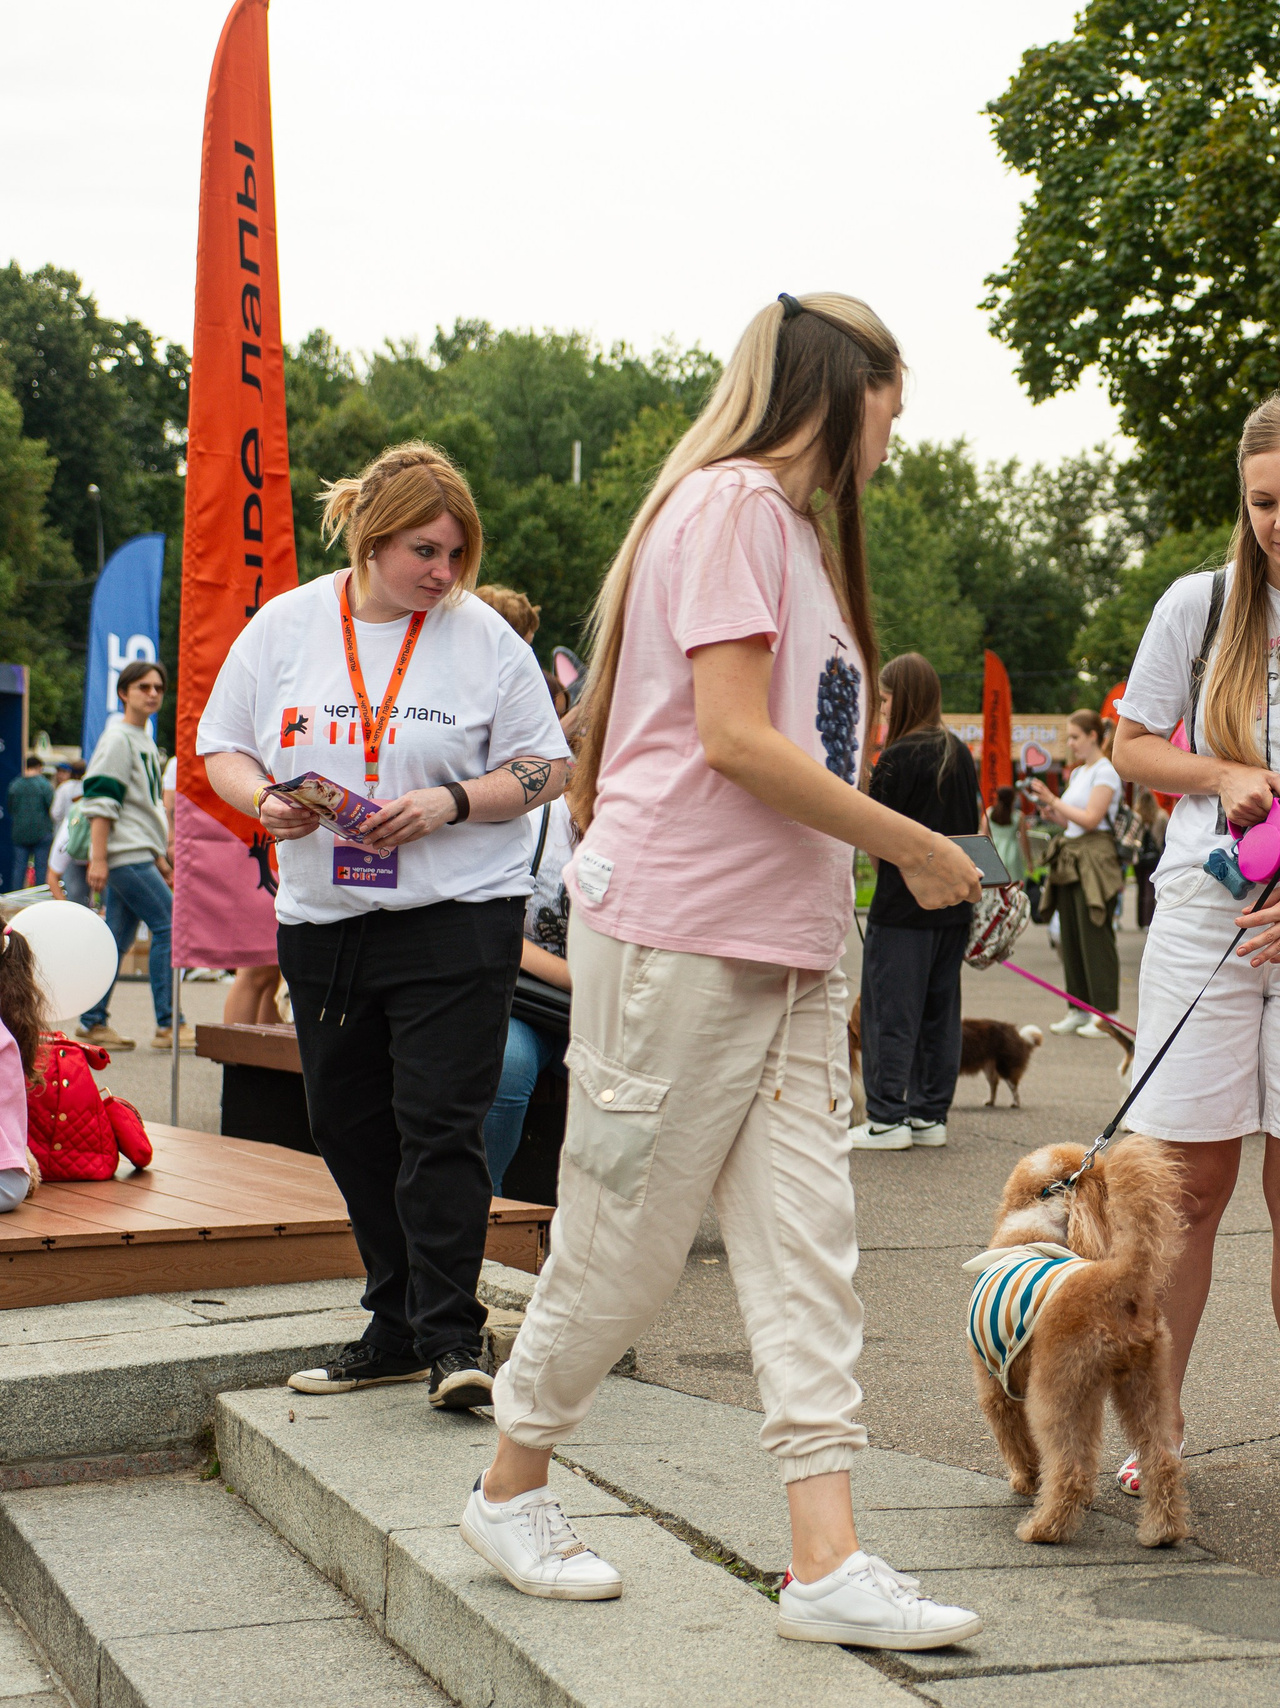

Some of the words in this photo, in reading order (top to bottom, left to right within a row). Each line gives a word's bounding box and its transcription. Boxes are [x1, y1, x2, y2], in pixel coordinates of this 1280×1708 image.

[234, 140, 263, 403] лапы
[241, 428, 264, 618] ыре
[344, 624, 354, 651] четыре
[399, 638, 413, 666] четыре
[409, 618, 420, 639] лапы
[348, 652, 357, 672] лапы
[322, 721, 402, 745] ФЕТ
[372, 715, 385, 744] четыре
[382, 695, 393, 715] лапы
[404, 706, 456, 725] лапы
